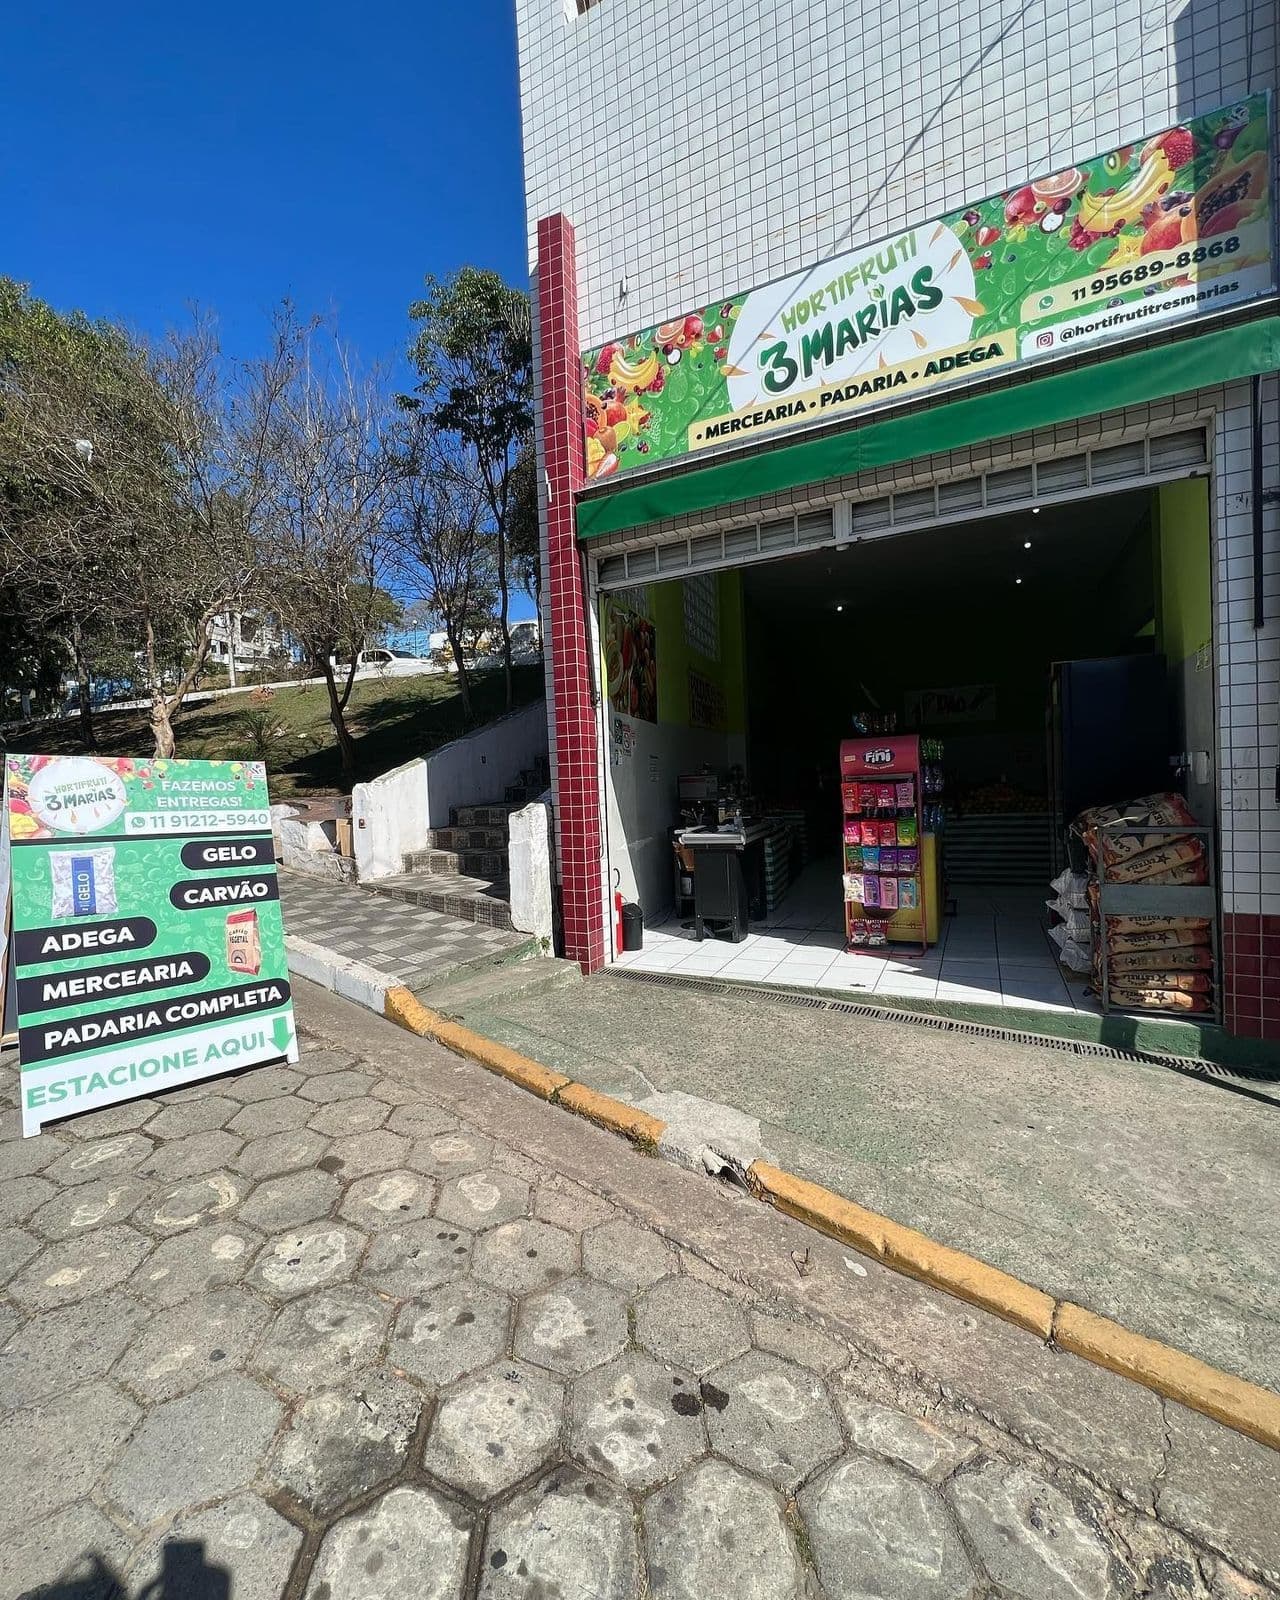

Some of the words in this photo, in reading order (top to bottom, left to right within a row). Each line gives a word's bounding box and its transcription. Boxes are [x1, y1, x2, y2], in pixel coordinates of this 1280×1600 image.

[780, 231, 918, 334] HORTIFRUTI
[1071, 286, 1087, 301] 11
[1090, 236, 1240, 295] 95689-8868
[1059, 280, 1240, 343] @hortifrutitresmarias
[758, 340, 799, 393] 3
[704, 399, 806, 440] MERCEARIA
[819, 370, 907, 408] PADARIA
[923, 342, 1004, 378] ADEGA
[54, 776, 108, 794] HORTIFRUTI
[161, 779, 237, 793] FAZEMOS
[45, 794, 63, 811] 3
[157, 796, 243, 809] ENTREGAS!
[150, 815, 166, 829] 11
[169, 813, 269, 828] 91212-5940
[202, 845, 257, 862] GELO
[77, 873, 91, 901] GELO
[183, 881, 269, 904] CARVÃO
[41, 926, 136, 954] ADEGA
[43, 960, 194, 1001] MERCEARIA
[44, 1010, 162, 1051] PADARIA
[165, 986, 282, 1023] COMPLETA
[26, 1048, 199, 1110] ESTACIONE
[203, 1031, 266, 1063] AQUI
